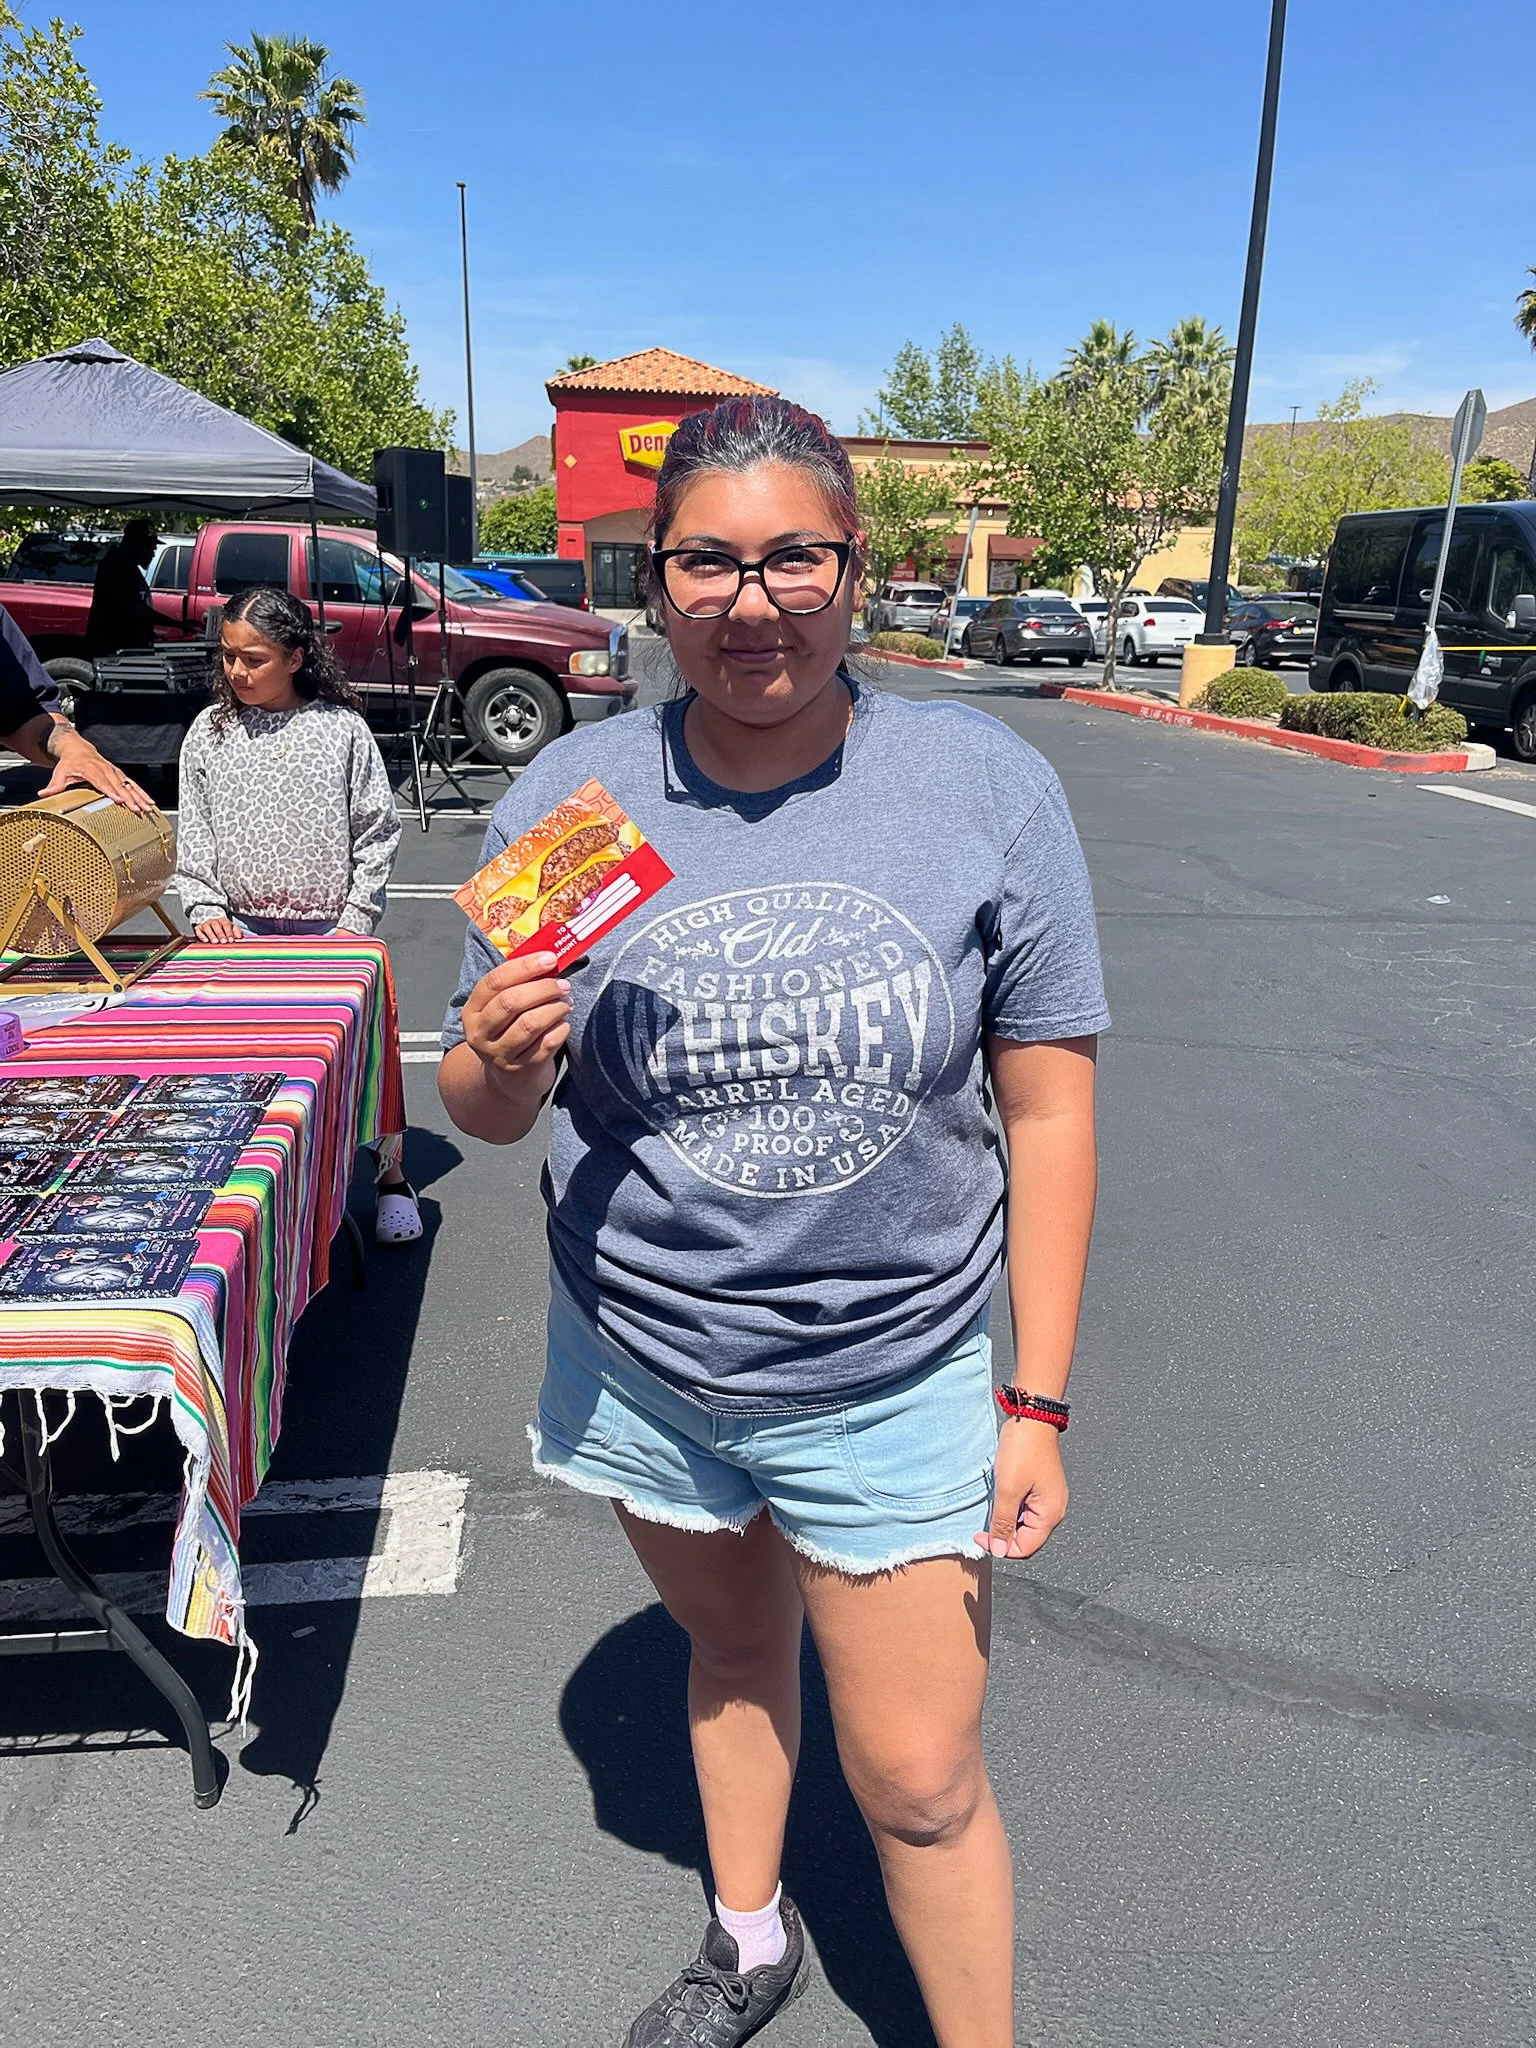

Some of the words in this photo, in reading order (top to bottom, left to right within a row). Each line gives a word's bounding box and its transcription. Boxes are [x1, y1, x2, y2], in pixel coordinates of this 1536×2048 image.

[553, 932, 573, 949] FROM
[556, 926, 567, 936] TO
[648, 902, 736, 952] HIGH
[747, 890, 893, 933] QUALITY
[719, 916, 825, 969] Old
[555, 938, 578, 958] MOUNT
[635, 939, 903, 1001] FASHIONED
[609, 958, 932, 1101] WHISKEY
[653, 1078, 799, 1121] BARREL
[812, 1078, 911, 1119] AGED
[747, 1104, 817, 1132] 100
[670, 1120, 761, 1188] MADE
[776, 1164, 816, 1190] IN
[832, 1124, 902, 1177] USA
[731, 1132, 834, 1157] PROOF
